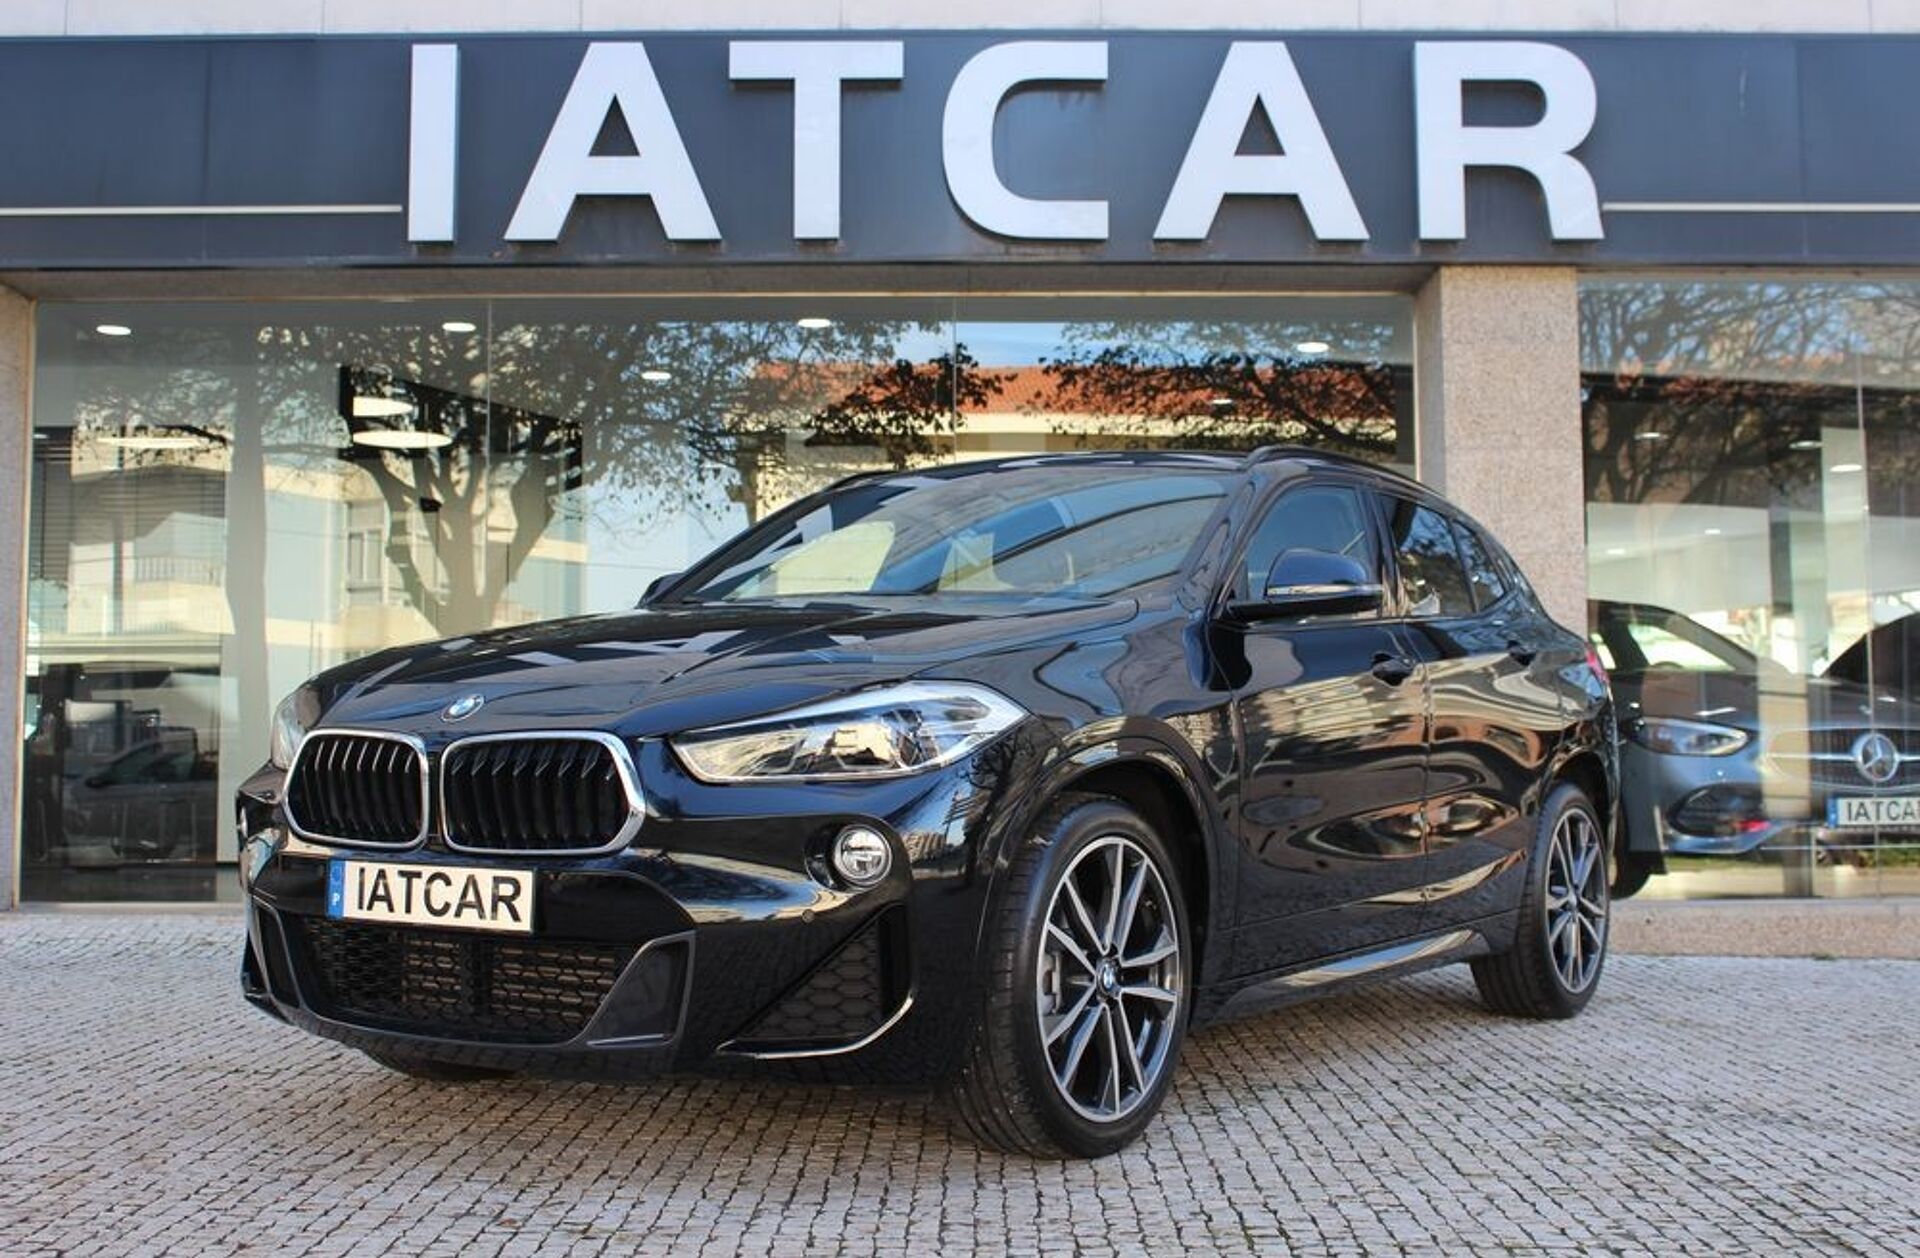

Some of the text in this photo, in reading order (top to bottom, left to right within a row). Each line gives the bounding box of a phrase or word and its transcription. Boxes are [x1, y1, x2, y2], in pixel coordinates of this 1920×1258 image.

[405, 40, 1604, 243] IATCAR
[331, 892, 341, 906] P
[357, 867, 522, 923] IATCAR
